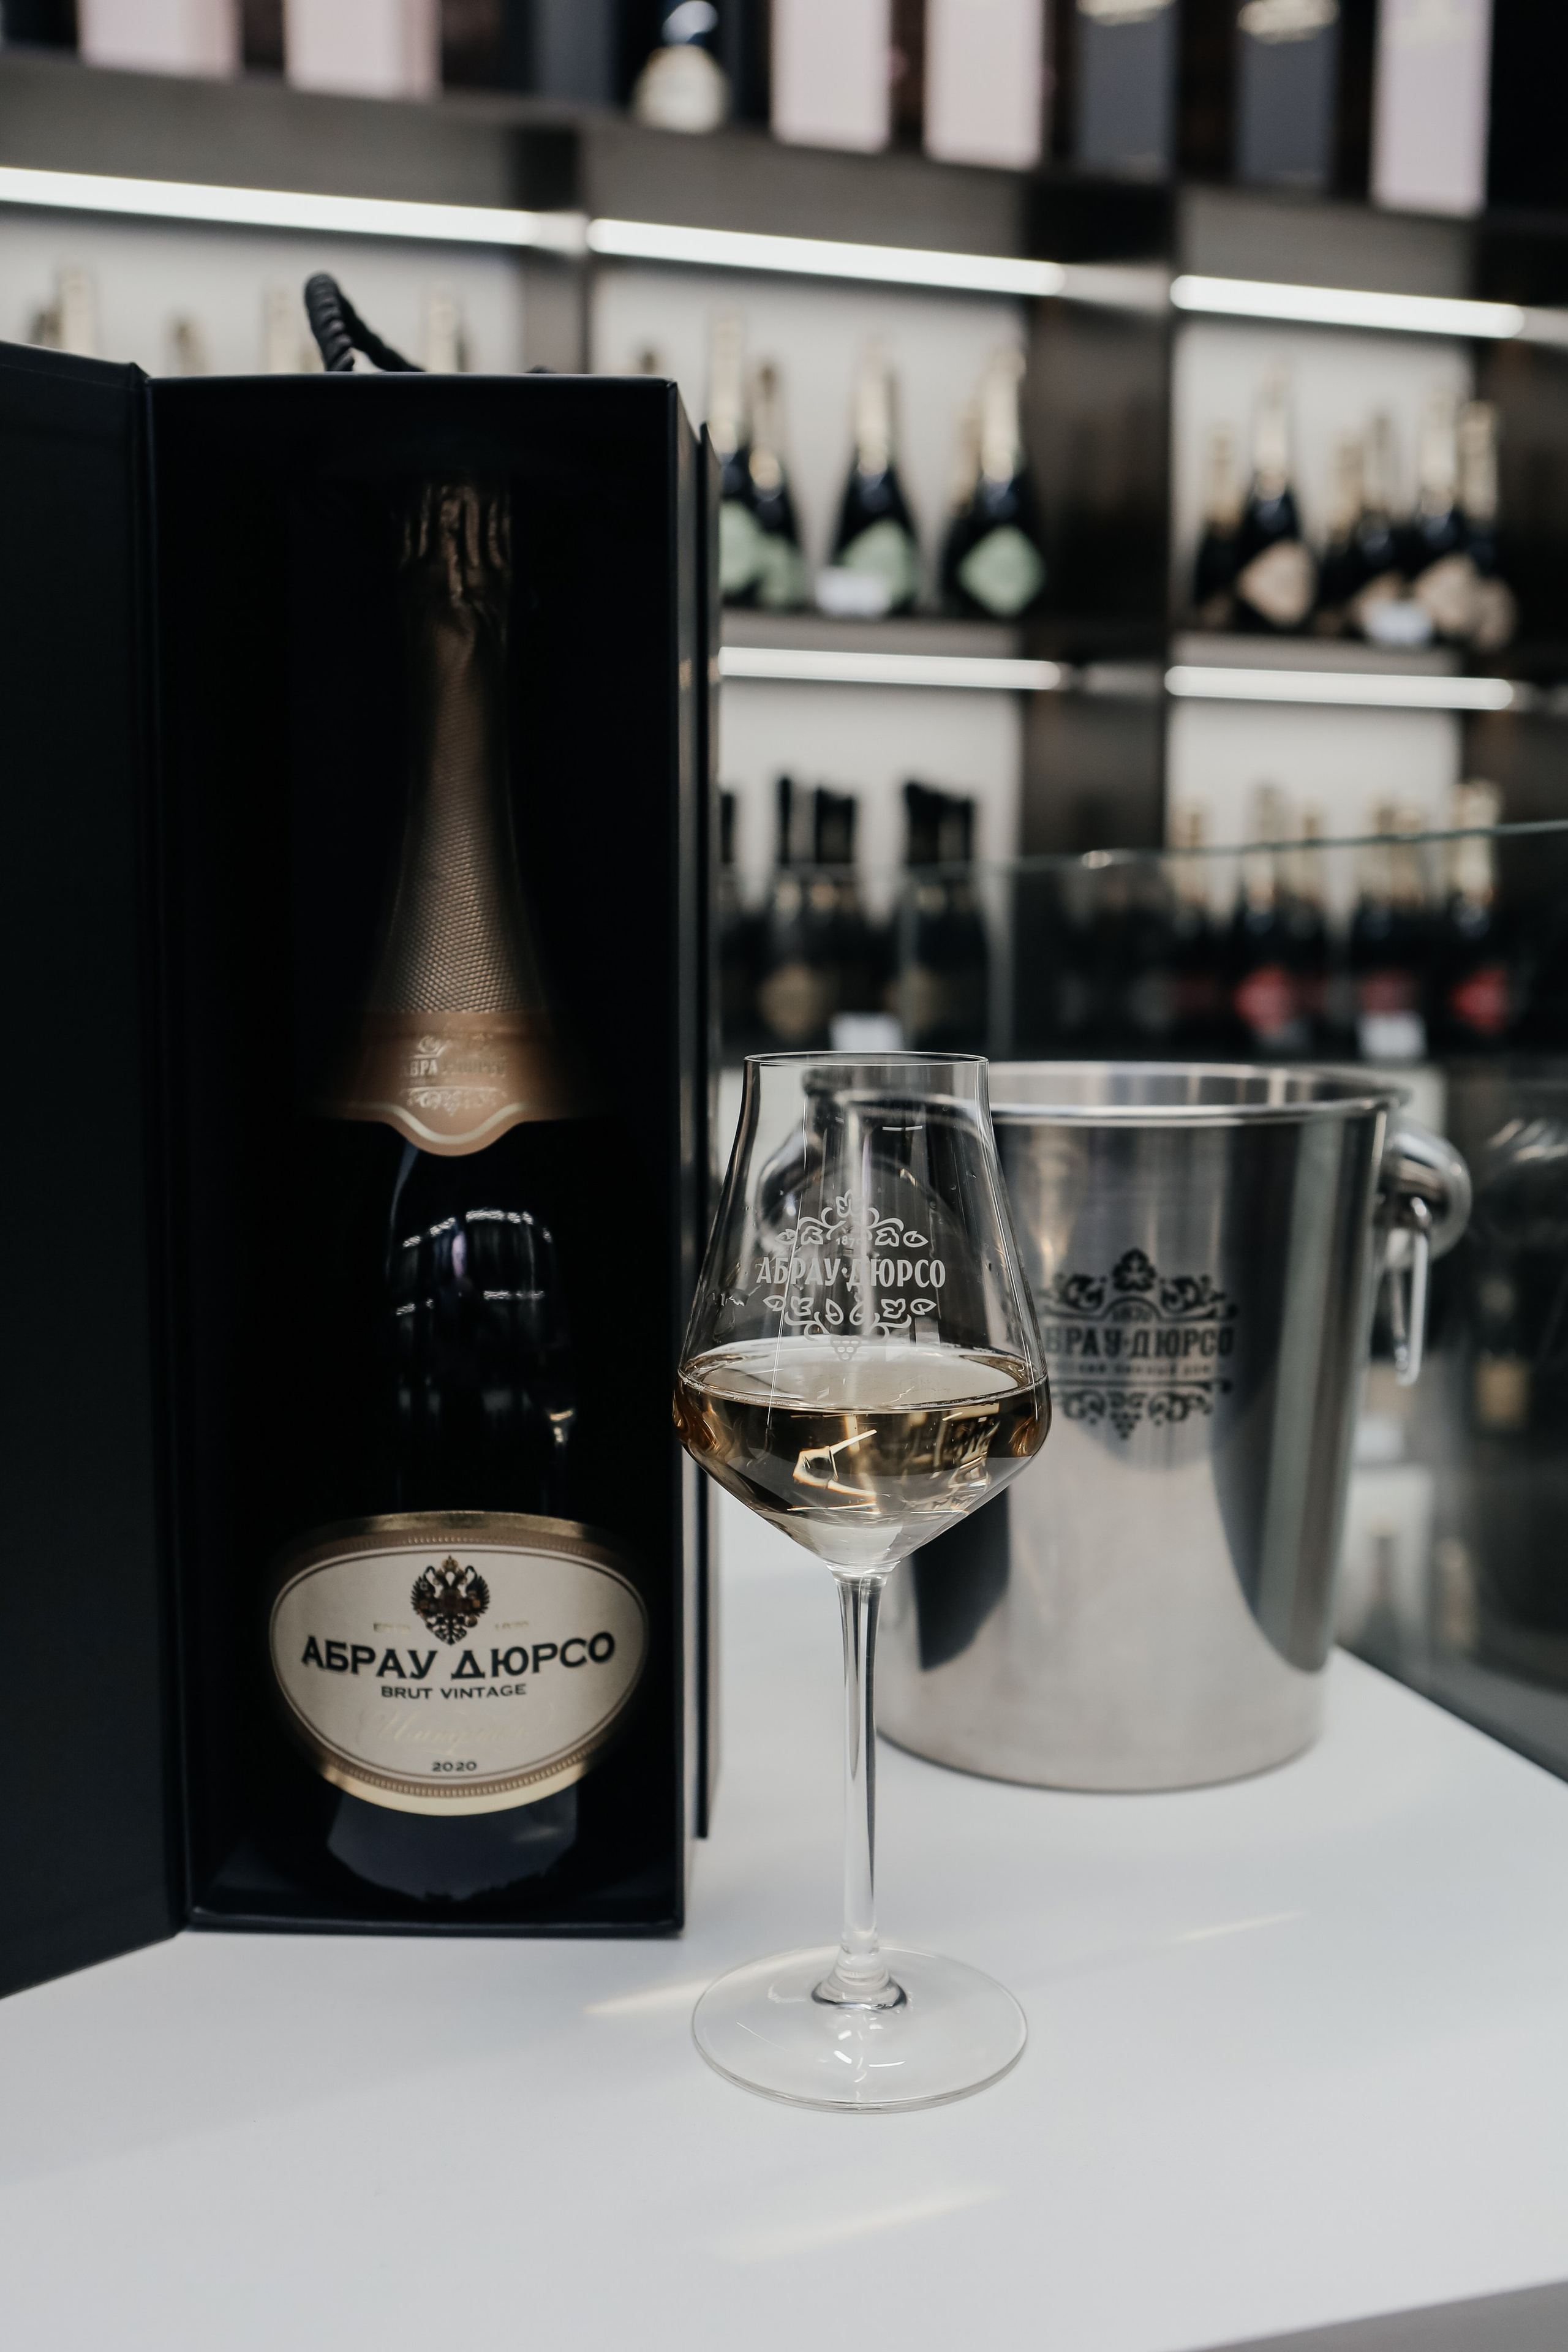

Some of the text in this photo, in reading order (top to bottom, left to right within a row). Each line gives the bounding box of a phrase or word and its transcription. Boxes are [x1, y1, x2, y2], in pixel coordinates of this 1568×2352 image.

[301, 1631, 616, 1680] АБРАУ ДЮРСО
[380, 1683, 527, 1700] BRUT VINTAGE
[431, 1760, 477, 1773] 2020
